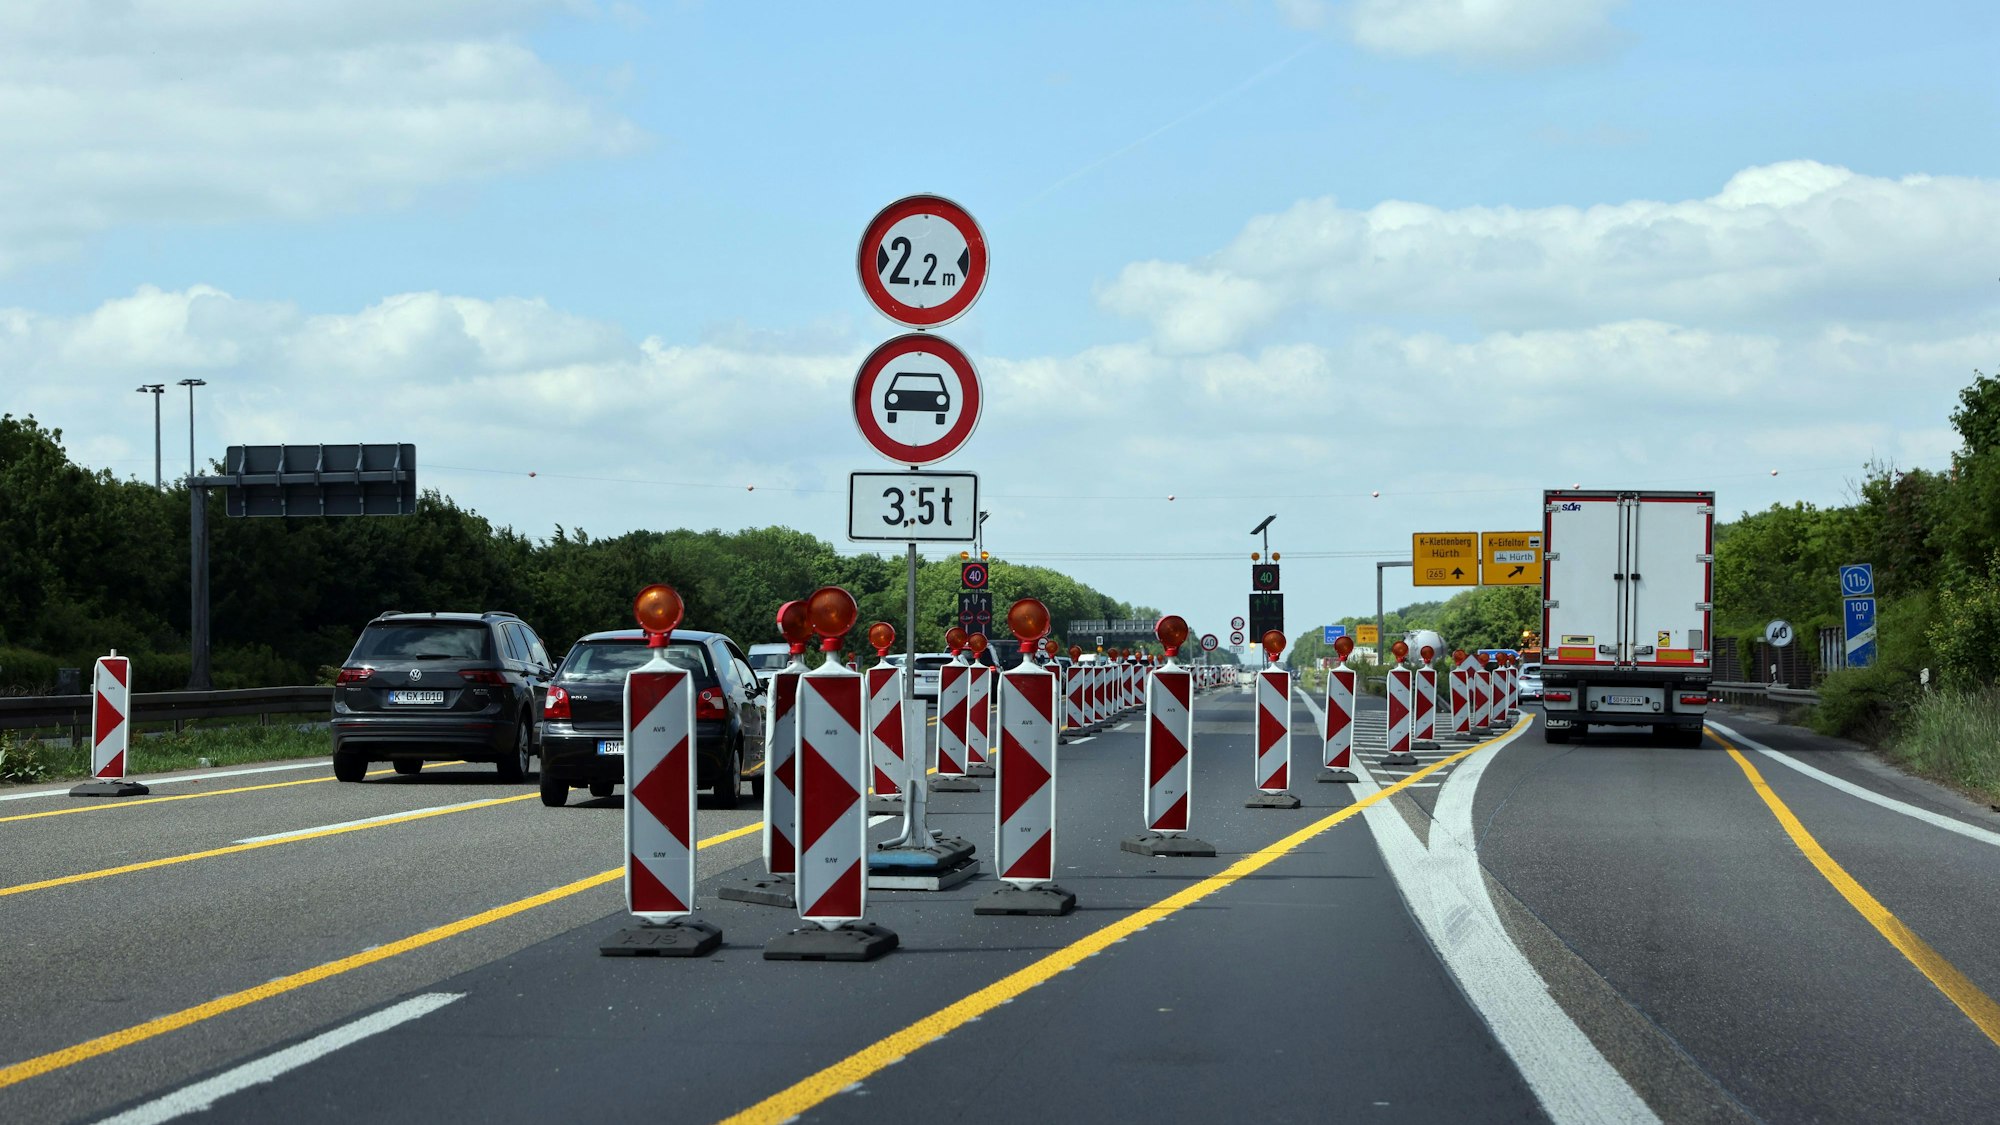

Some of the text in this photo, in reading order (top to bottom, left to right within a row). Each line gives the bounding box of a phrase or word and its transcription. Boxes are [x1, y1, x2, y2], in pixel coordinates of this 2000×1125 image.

[889, 236, 956, 287] 2,2 m
[1420, 537, 1472, 547] K-Klettenberg
[1488, 538, 1525, 547] K-Eifeltor
[1432, 549, 1460, 558] Hürth
[1509, 552, 1533, 561] Hürth
[969, 570, 981, 581] 40
[1260, 572, 1272, 583] 40
[1429, 570, 1443, 578] 265
[1847, 573, 1867, 587] 11b
[1851, 602, 1868, 612] 100
[1772, 627, 1787, 639] 40
[1204, 638, 1215, 647] 40
[394, 691, 442, 701] K GX 1010
[605, 742, 620, 752] BM
